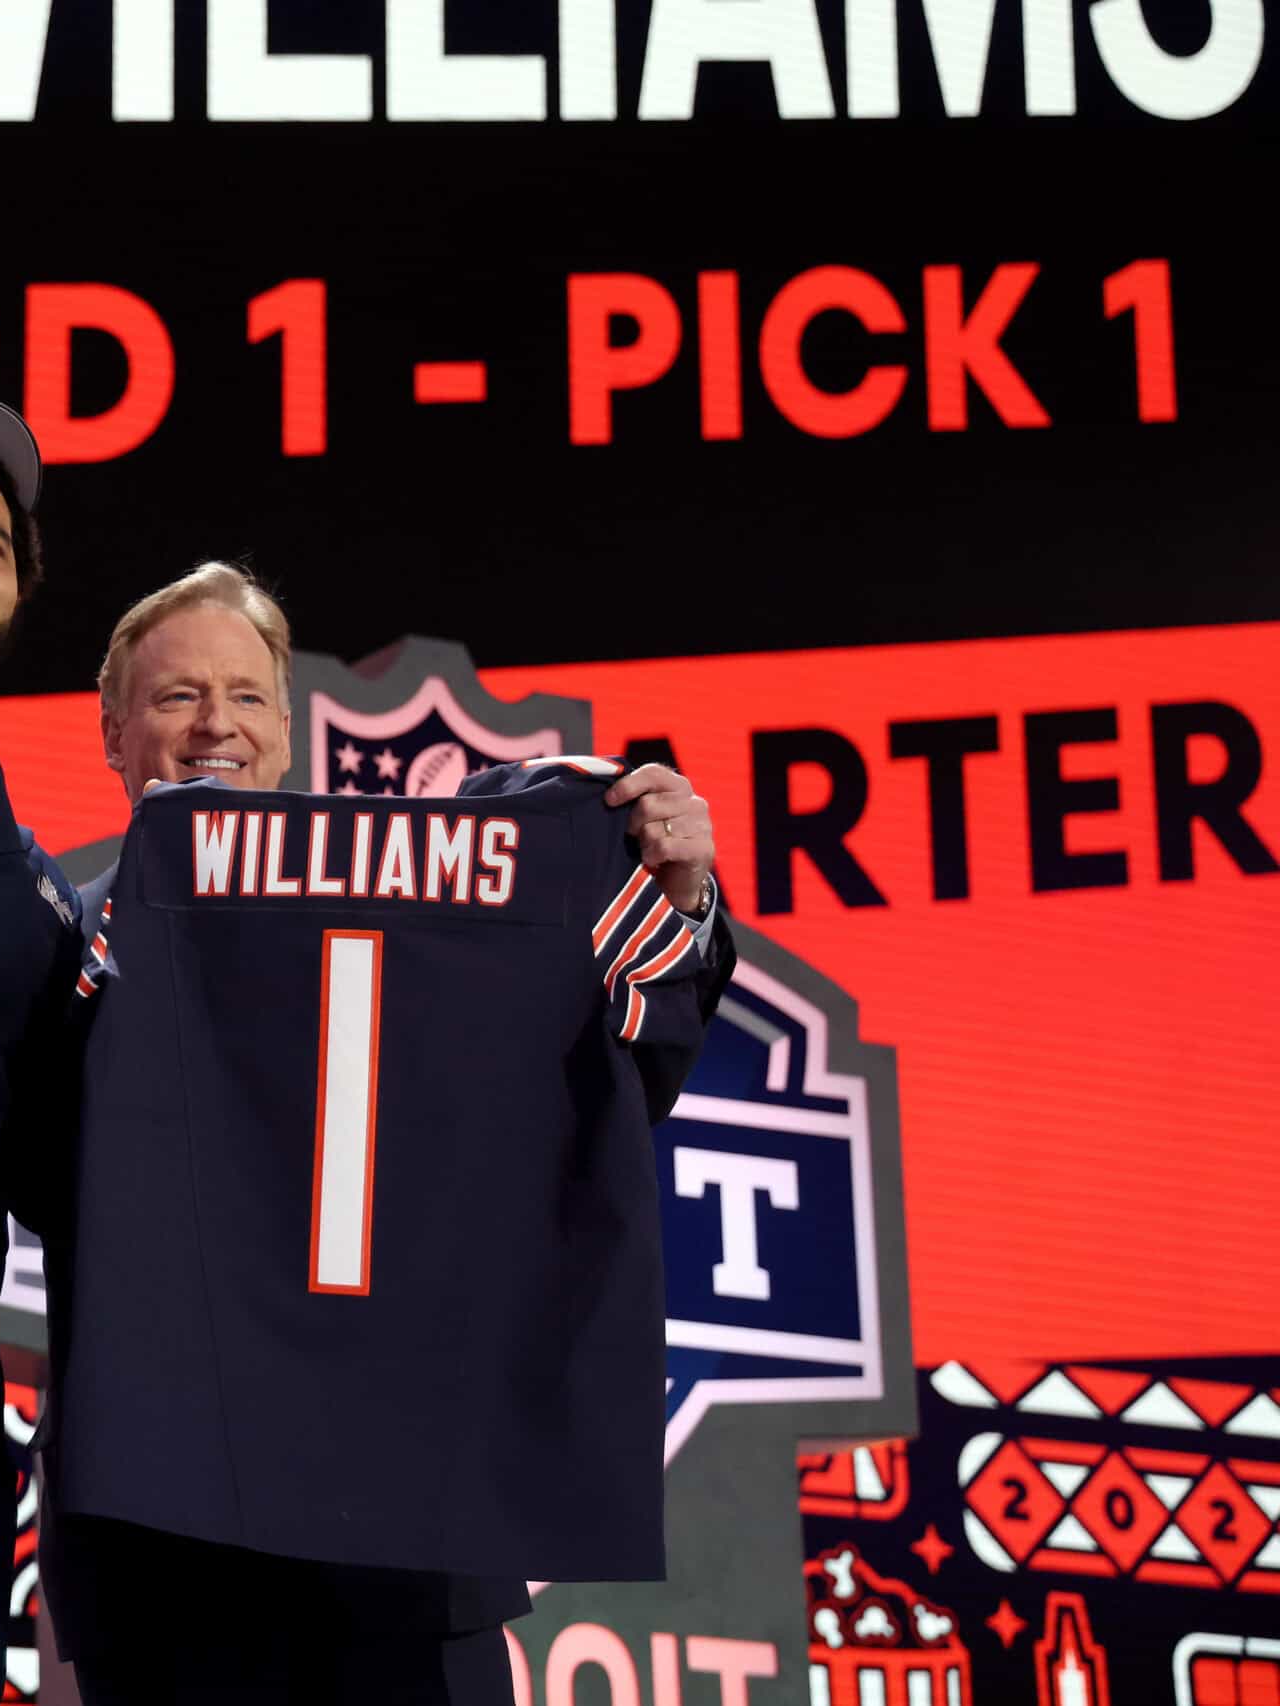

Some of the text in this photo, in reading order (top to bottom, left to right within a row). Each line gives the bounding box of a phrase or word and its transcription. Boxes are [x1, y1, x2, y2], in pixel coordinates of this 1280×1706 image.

[247, 279, 327, 456] 1
[568, 263, 1050, 445] PICK
[1103, 260, 1177, 423] 1
[191, 810, 521, 907] WILLIAMS
[307, 928, 385, 1297] 1
